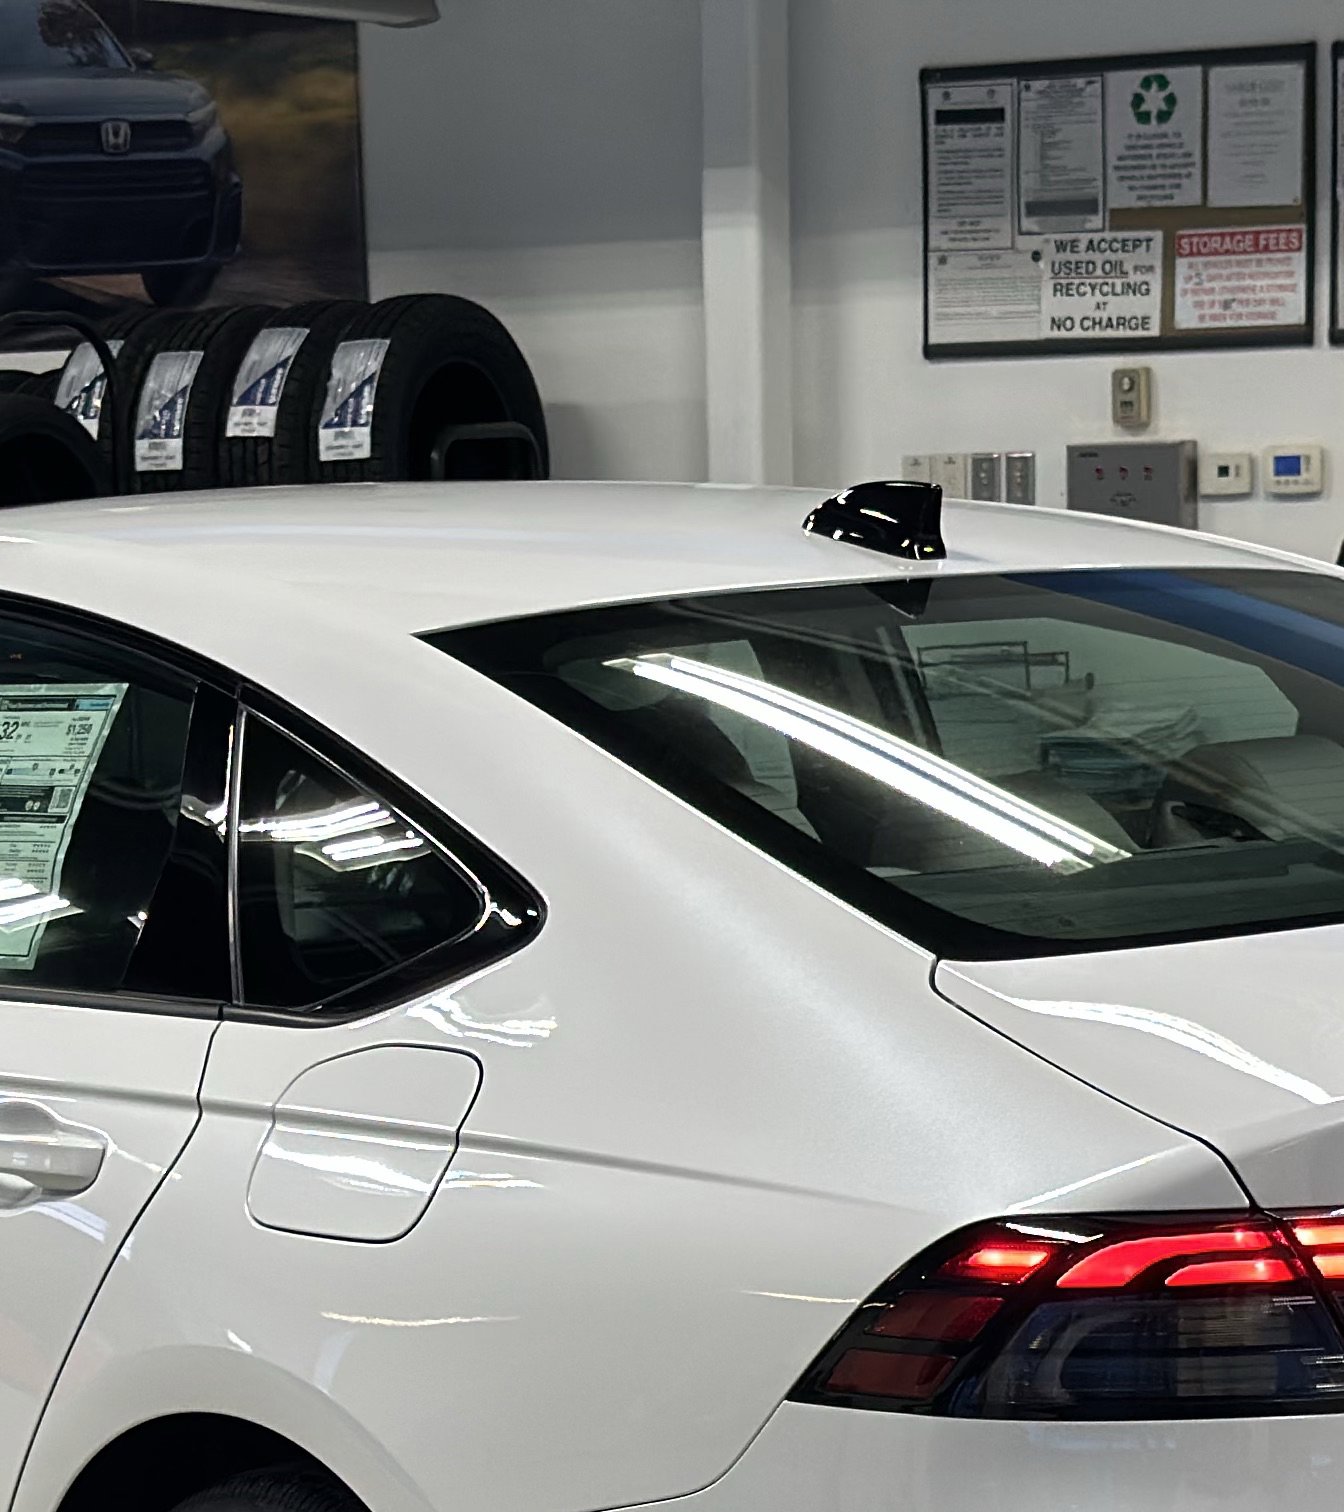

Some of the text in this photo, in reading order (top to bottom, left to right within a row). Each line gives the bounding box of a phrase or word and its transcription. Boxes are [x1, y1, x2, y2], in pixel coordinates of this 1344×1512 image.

[1054, 238, 1154, 254] WE ACCEPT
[1178, 230, 1300, 255] STORAGE FEES
[1050, 261, 1097, 276] USED
[1101, 260, 1129, 276] OIL
[1052, 281, 1151, 298] RECYCLING
[1050, 316, 1152, 332] NO CHARGE
